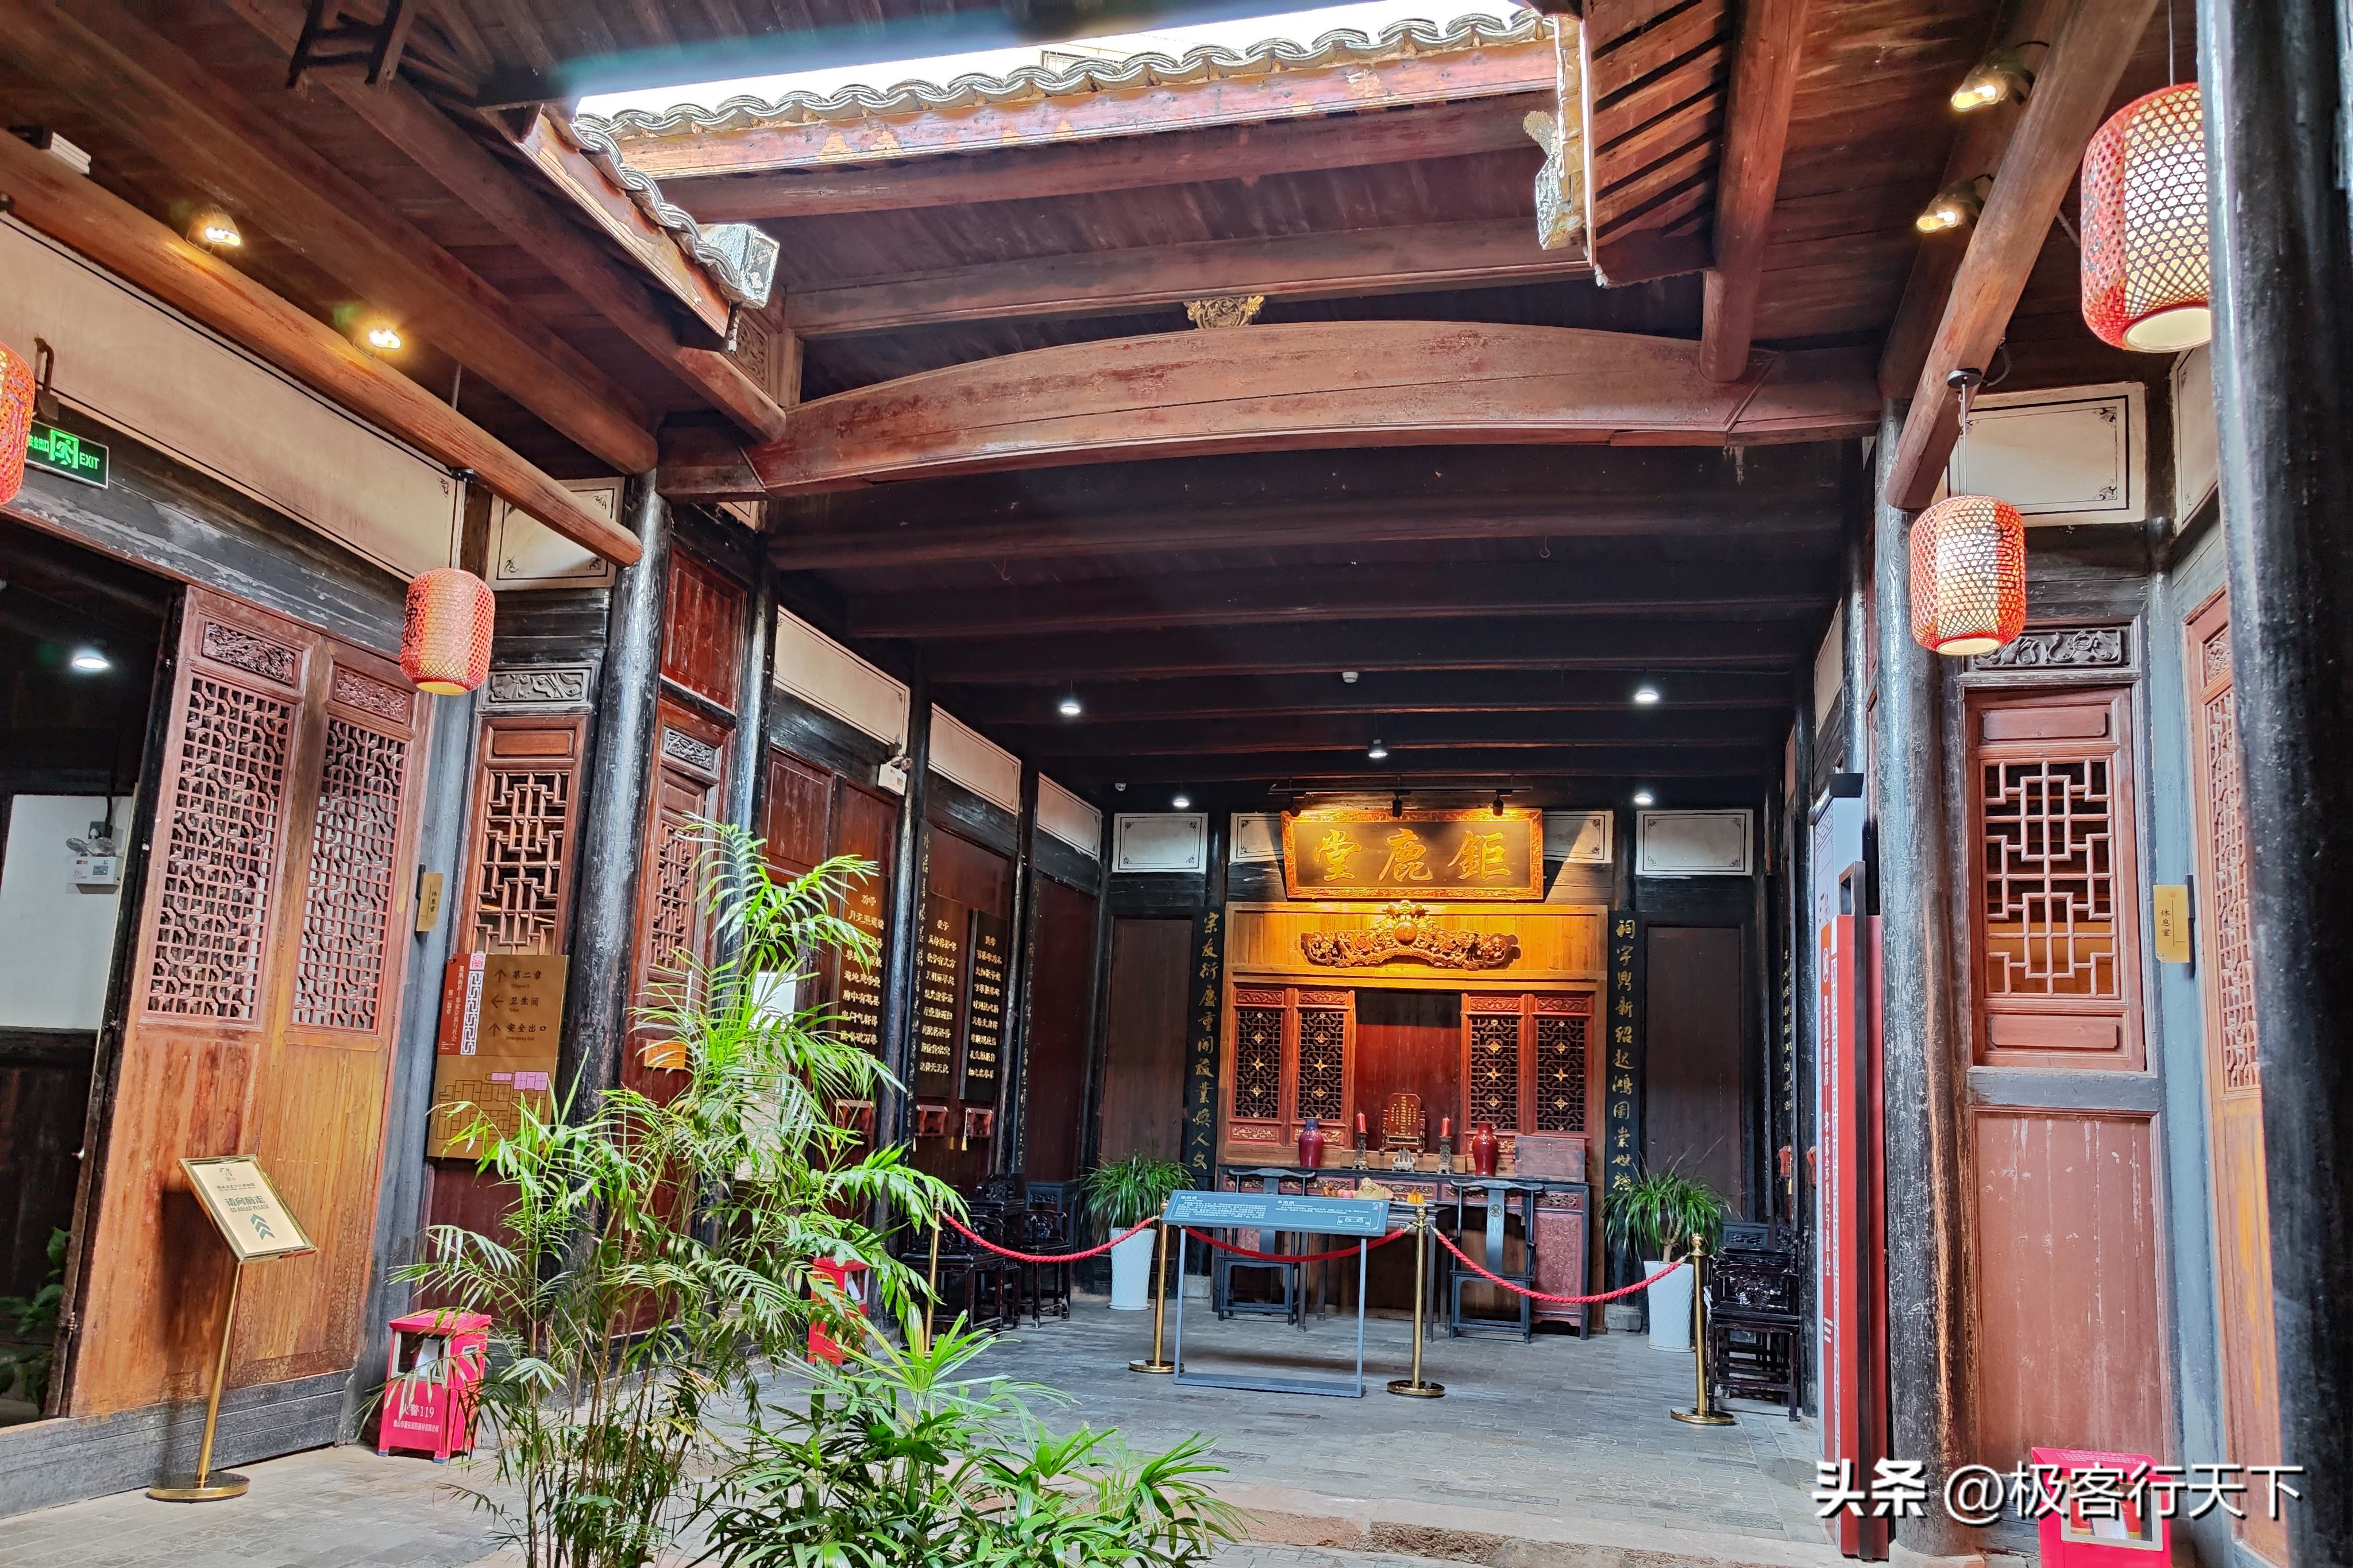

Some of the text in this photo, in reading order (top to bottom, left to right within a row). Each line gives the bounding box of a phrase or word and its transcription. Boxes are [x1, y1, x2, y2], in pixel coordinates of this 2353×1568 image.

[79, 452, 100, 470] EXIT
[2161, 909, 2171, 937] 休息室
[513, 970, 542, 980] 第二章
[509, 997, 539, 1007] 卫生间
[507, 1022, 547, 1033] 安全出口
[224, 1195, 266, 1207] 请向前走
[403, 1403, 435, 1419] 火警119
